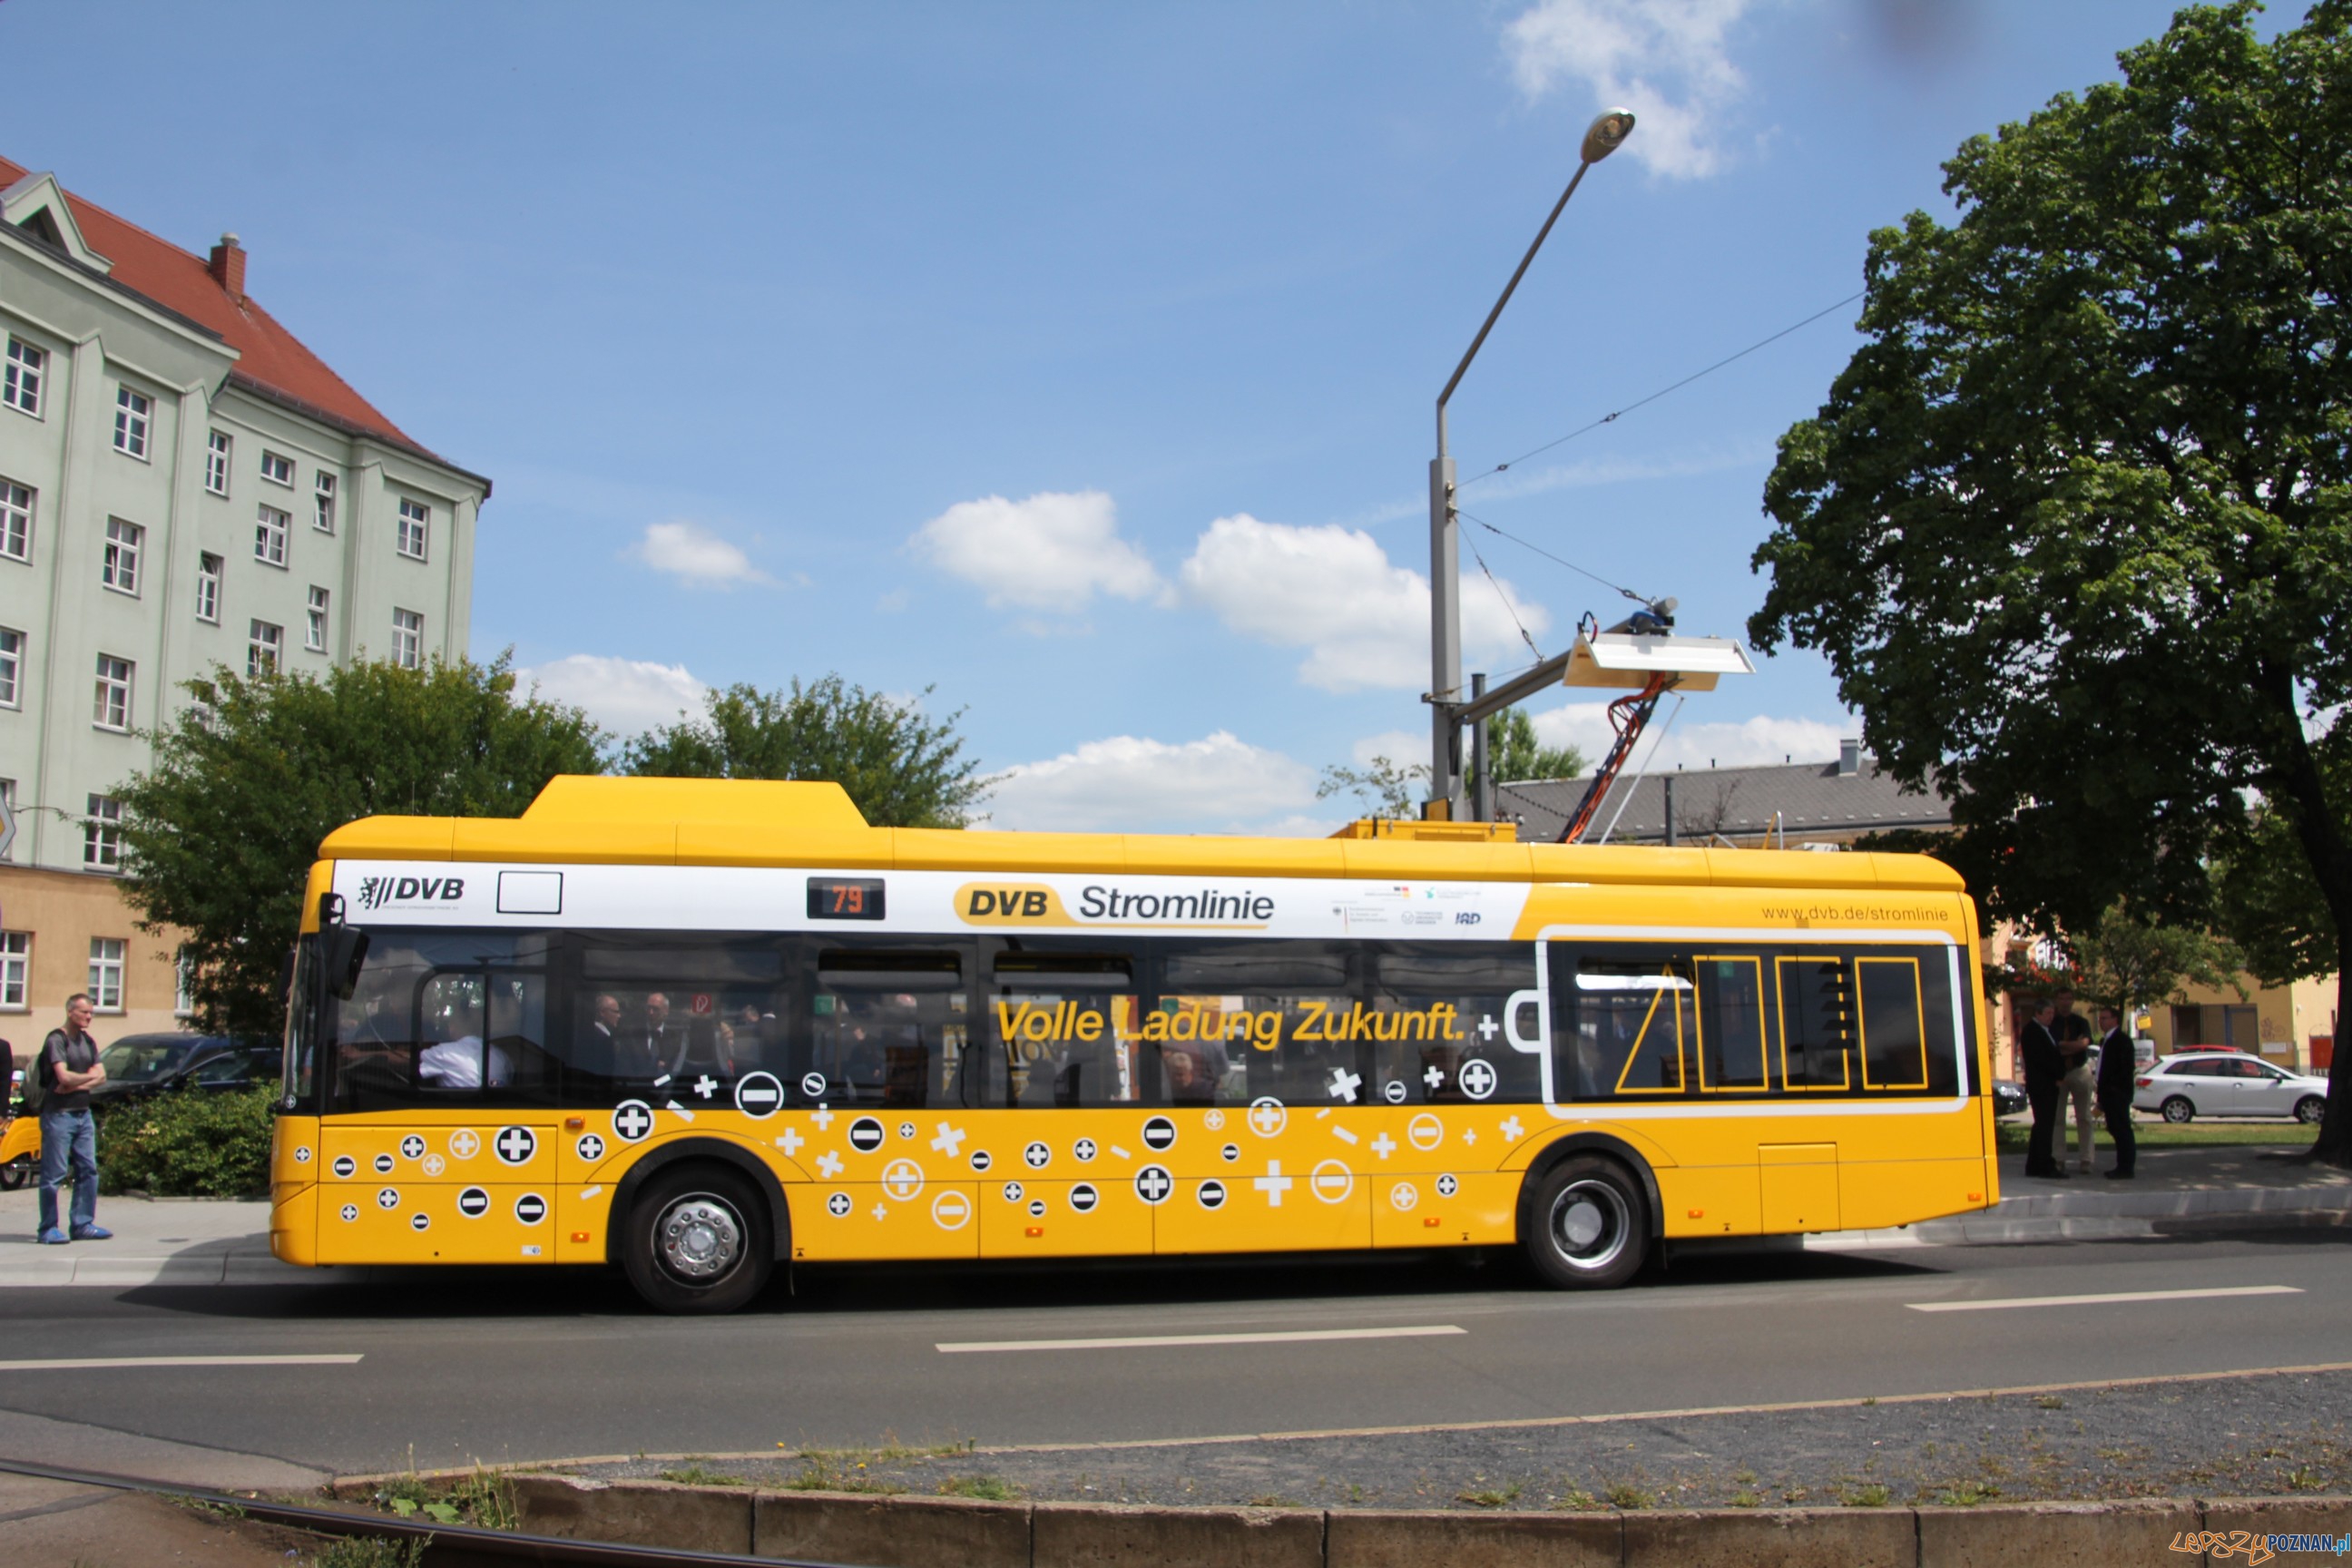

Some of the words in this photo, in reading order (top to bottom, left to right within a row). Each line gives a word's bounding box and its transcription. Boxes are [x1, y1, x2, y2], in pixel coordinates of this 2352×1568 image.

[395, 877, 465, 900] DVB
[832, 886, 863, 913] 79
[967, 890, 1048, 917] DVB
[1079, 885, 1275, 920] Stromlinie
[1761, 905, 1949, 922] www.dvb.de/stromlinie
[997, 1000, 1102, 1042] Volle
[1116, 1000, 1282, 1051] Ladung
[1292, 1000, 1465, 1042] Zukunft.
